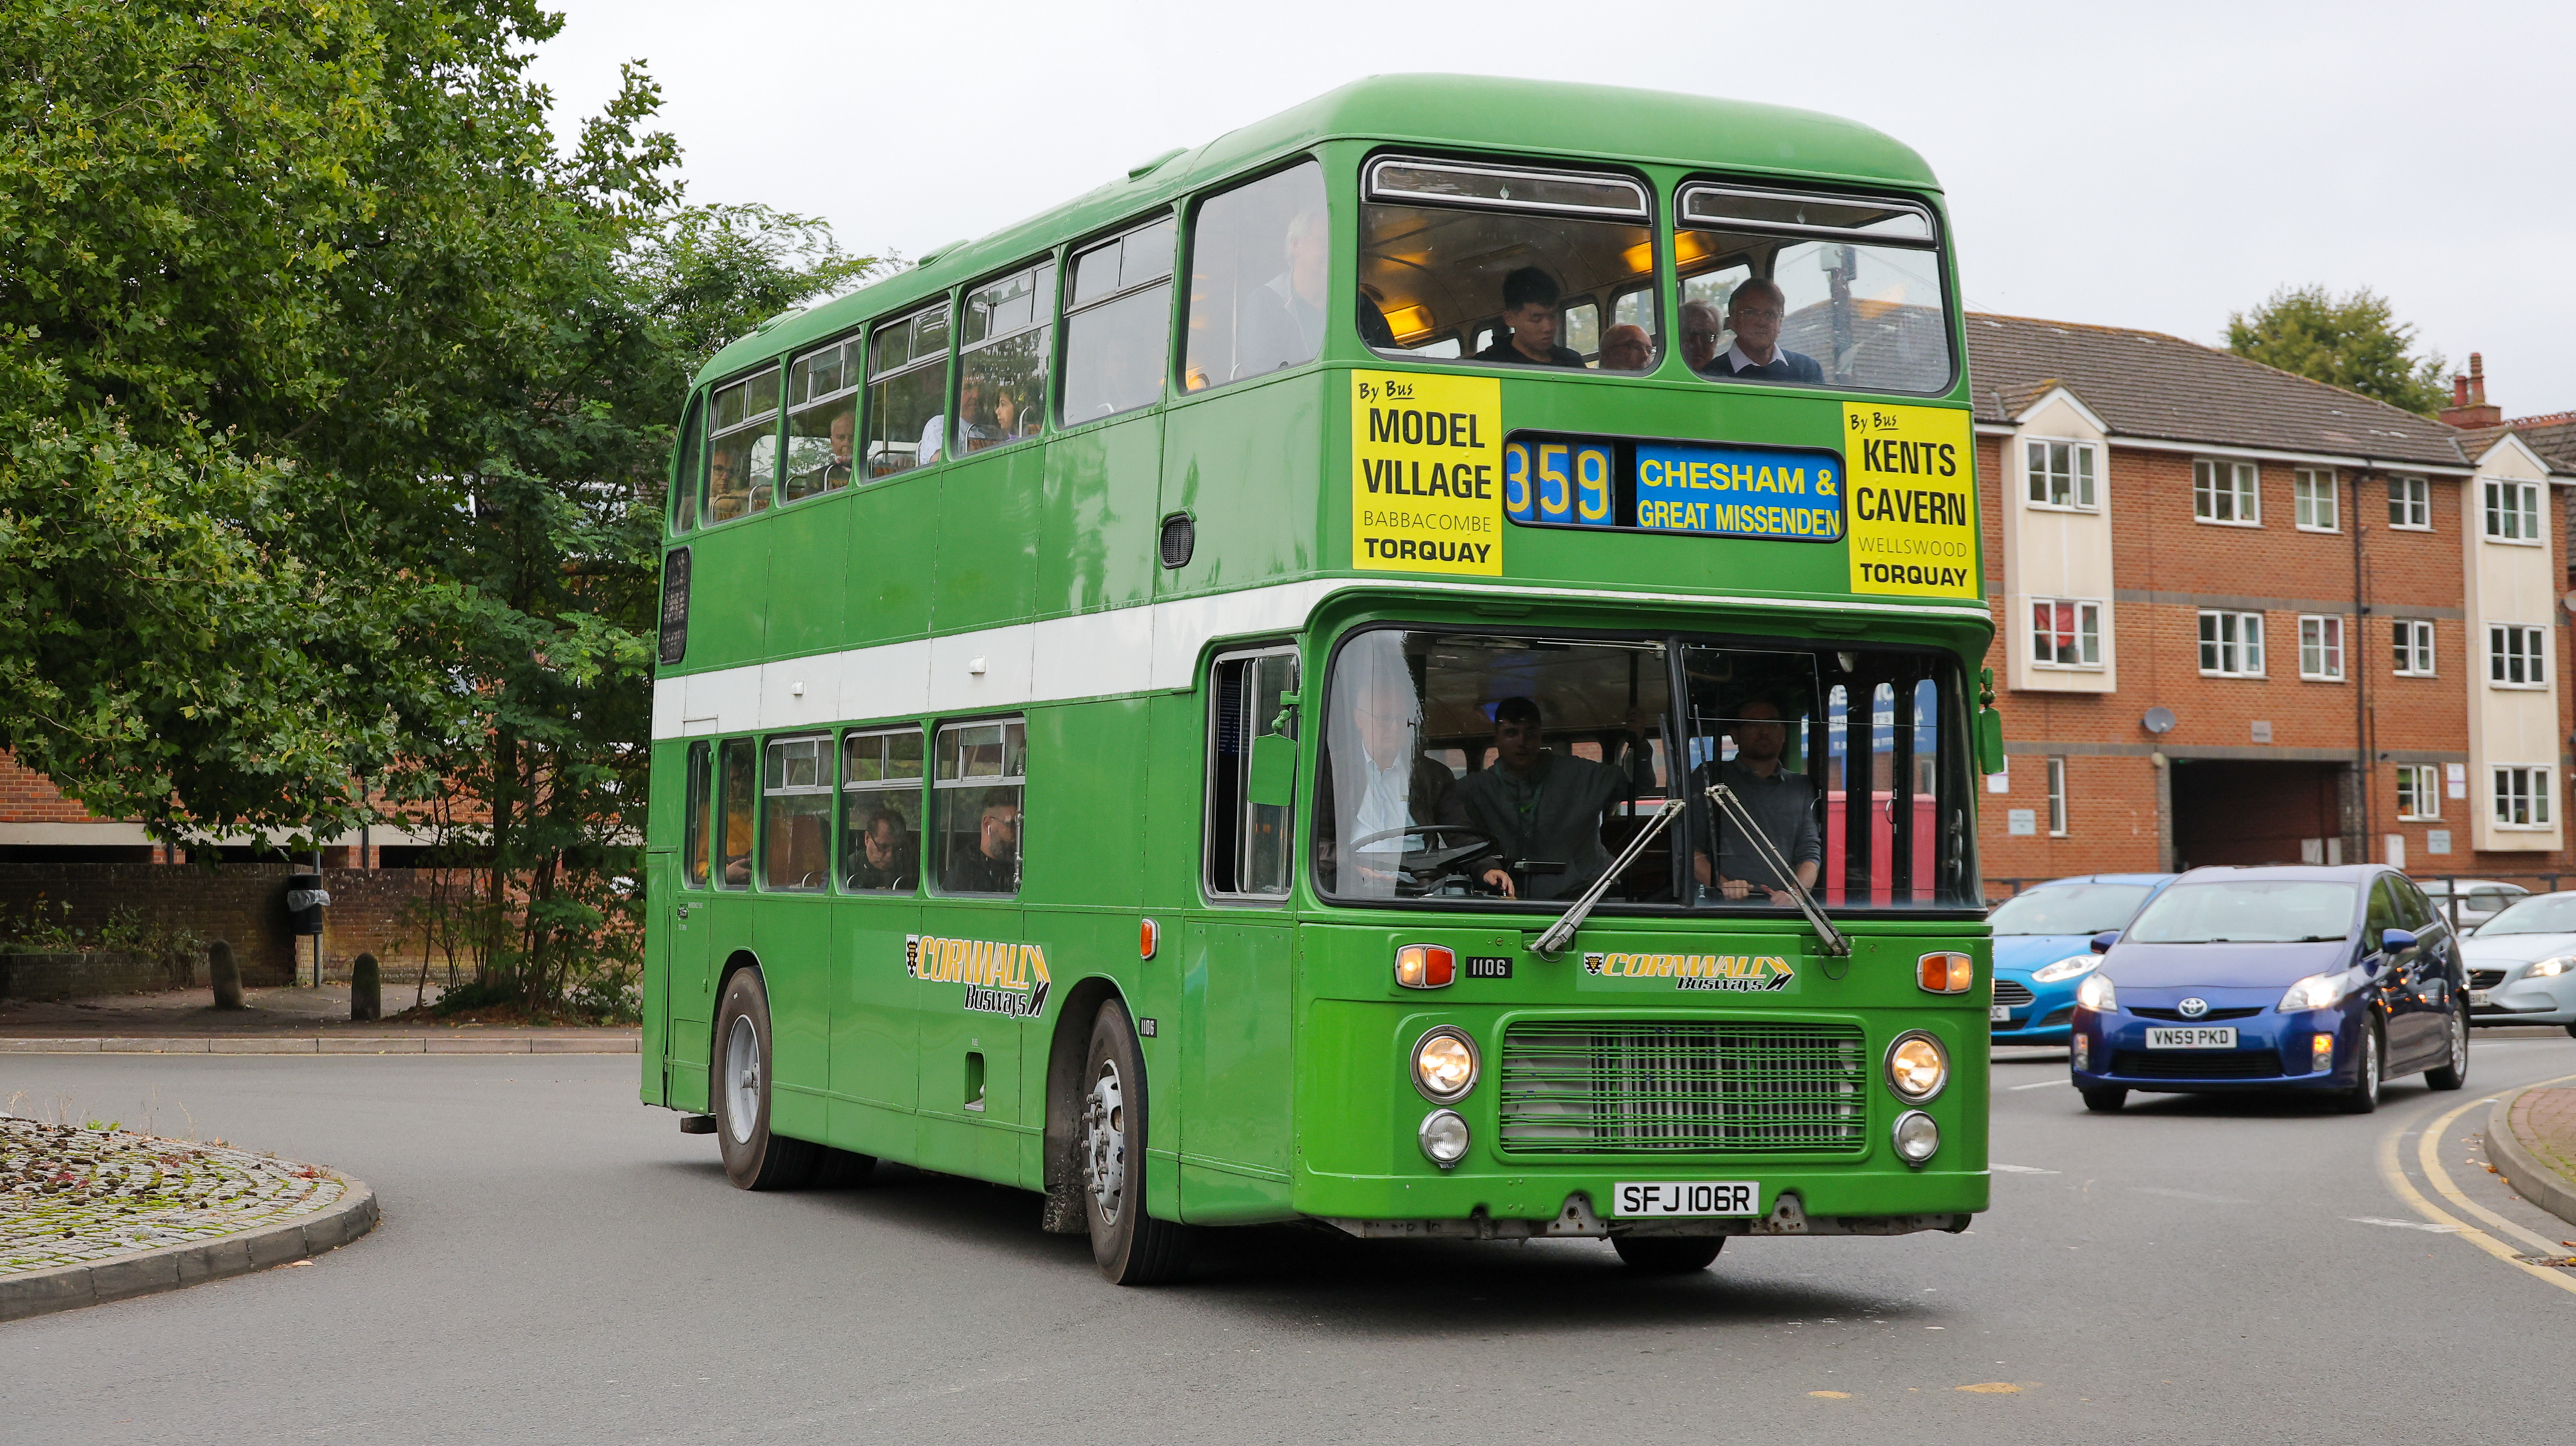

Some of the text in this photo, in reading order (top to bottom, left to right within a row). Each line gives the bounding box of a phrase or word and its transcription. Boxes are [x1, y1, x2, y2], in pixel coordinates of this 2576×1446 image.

[1358, 380, 1413, 403] By Bus
[1370, 408, 1485, 448] MODEL
[1850, 412, 1897, 434] By Bus
[1864, 439, 1956, 477] KENTS
[1362, 459, 1492, 499] VILLAGE
[1506, 443, 1609, 520] 359
[1640, 459, 1838, 496] CHESHAM &
[1638, 500, 1840, 535] GREAT MISSENDEN
[1857, 487, 1966, 526] CAVERN
[1364, 510, 1491, 532] BABBACOMBE
[1364, 538, 1491, 563] TORQUAY
[1858, 537, 1967, 557] WELLSWOOD
[1860, 563, 1968, 587] TORQUAY
[917, 936, 1030, 990] CORNWALL
[1472, 958, 1506, 976] 1106
[1601, 953, 1768, 979] CORNWALL
[1676, 977, 1765, 993] Busways
[964, 984, 1028, 1019] Busways
[1141, 1019, 1155, 1036] 1106
[2154, 1030, 2229, 1044] VN59 PKD
[1623, 1186, 1680, 1212] SFJ
